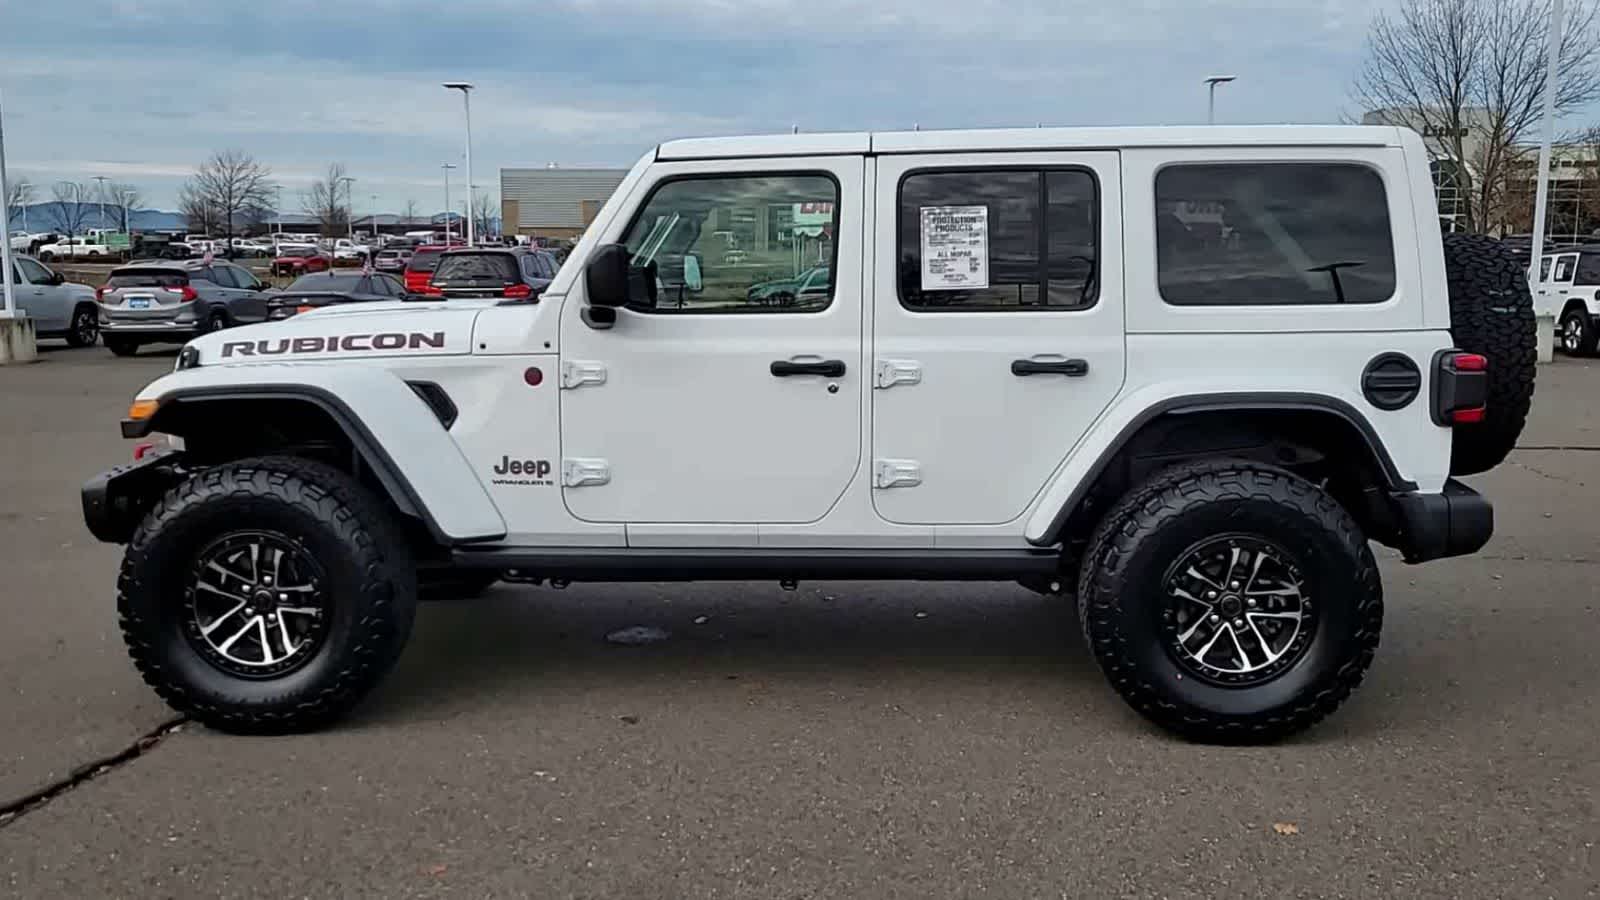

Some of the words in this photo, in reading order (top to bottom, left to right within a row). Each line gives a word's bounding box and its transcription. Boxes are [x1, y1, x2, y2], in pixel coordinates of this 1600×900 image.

[932, 216, 976, 224] PROTECTION
[935, 223, 973, 232] PRODUCTS
[221, 332, 445, 358] RUBICON
[493, 455, 551, 479] Jeep
